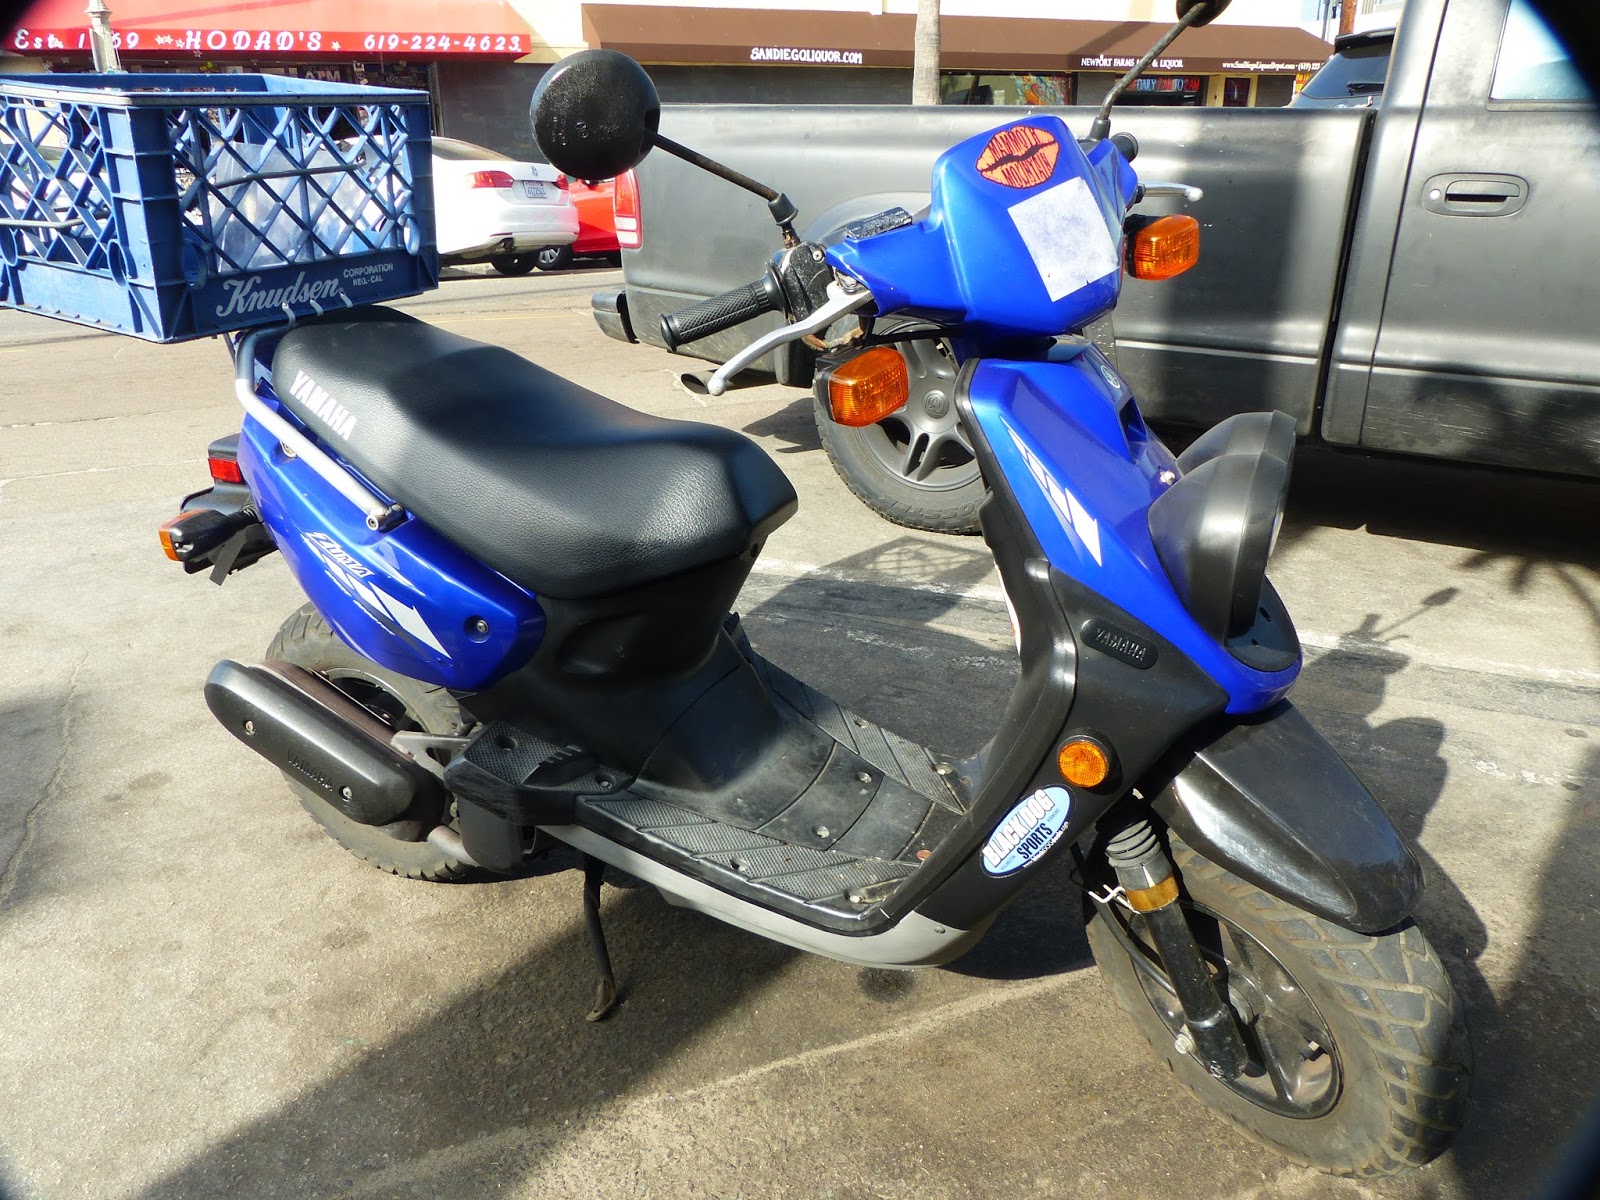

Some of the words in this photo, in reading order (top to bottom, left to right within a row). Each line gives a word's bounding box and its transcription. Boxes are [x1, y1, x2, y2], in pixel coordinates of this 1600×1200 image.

[78, 32, 139, 49] 169
[185, 30, 322, 51] HODAD'S
[364, 34, 520, 52] 619-224-4623
[750, 47, 863, 64] SANDIEGOLIQUOR.COM
[1081, 57, 1112, 67] NEWPORT
[1113, 58, 1134, 67] FARMS
[1152, 59, 1158, 67] &
[1160, 59, 1183, 69] LIQUOR
[1136, 78, 1157, 91] DAILY
[343, 263, 394, 278] CORPORATION
[216, 271, 340, 317] Knudsen
[289, 370, 358, 441] YAMAHA
[1096, 628, 1147, 661] YAMAHA
[287, 750, 333, 791] YAMAHA
[982, 812, 1031, 868] BLACK
[1017, 789, 1055, 830] DOG
[1016, 822, 1053, 859] SPORTS
